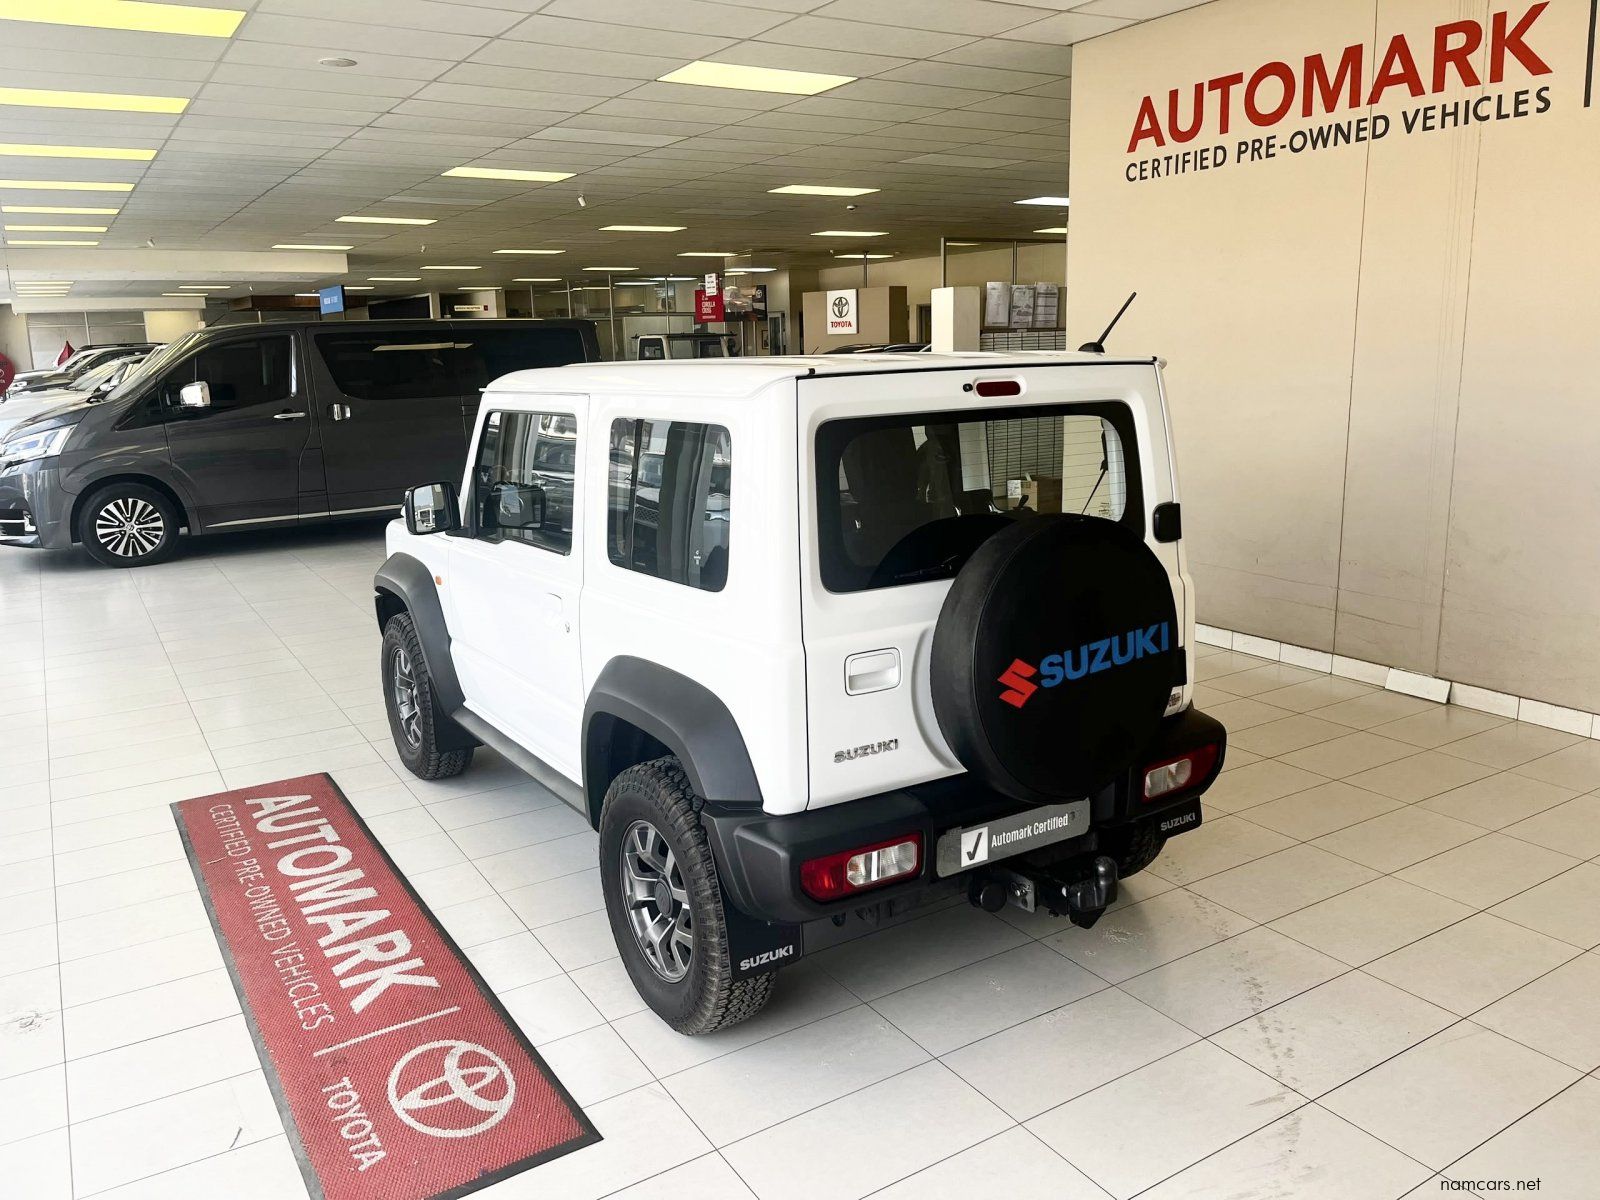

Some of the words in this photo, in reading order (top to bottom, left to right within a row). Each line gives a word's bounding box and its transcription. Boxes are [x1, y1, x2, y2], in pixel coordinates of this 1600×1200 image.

[1126, 1, 1553, 154] AUTOMARK
[1125, 145, 1228, 183] CERTIFIED
[1236, 113, 1390, 164] PRE-OWNED
[1401, 86, 1552, 135] VEHICLES
[1039, 621, 1169, 689] SUZUKI
[833, 738, 899, 764] SUZUKI
[991, 824, 1033, 848] Automark
[1033, 813, 1070, 836] Certified
[1160, 811, 1196, 832] SUZUKI
[209, 803, 252, 857] CERTIFIED
[233, 857, 293, 941] PRE-OWNED
[270, 941, 336, 1031] VEHICLES
[245, 794, 440, 1015] AUTOMARK
[739, 944, 794, 972] SUZUKI
[321, 1076, 387, 1172] TOYOTA
